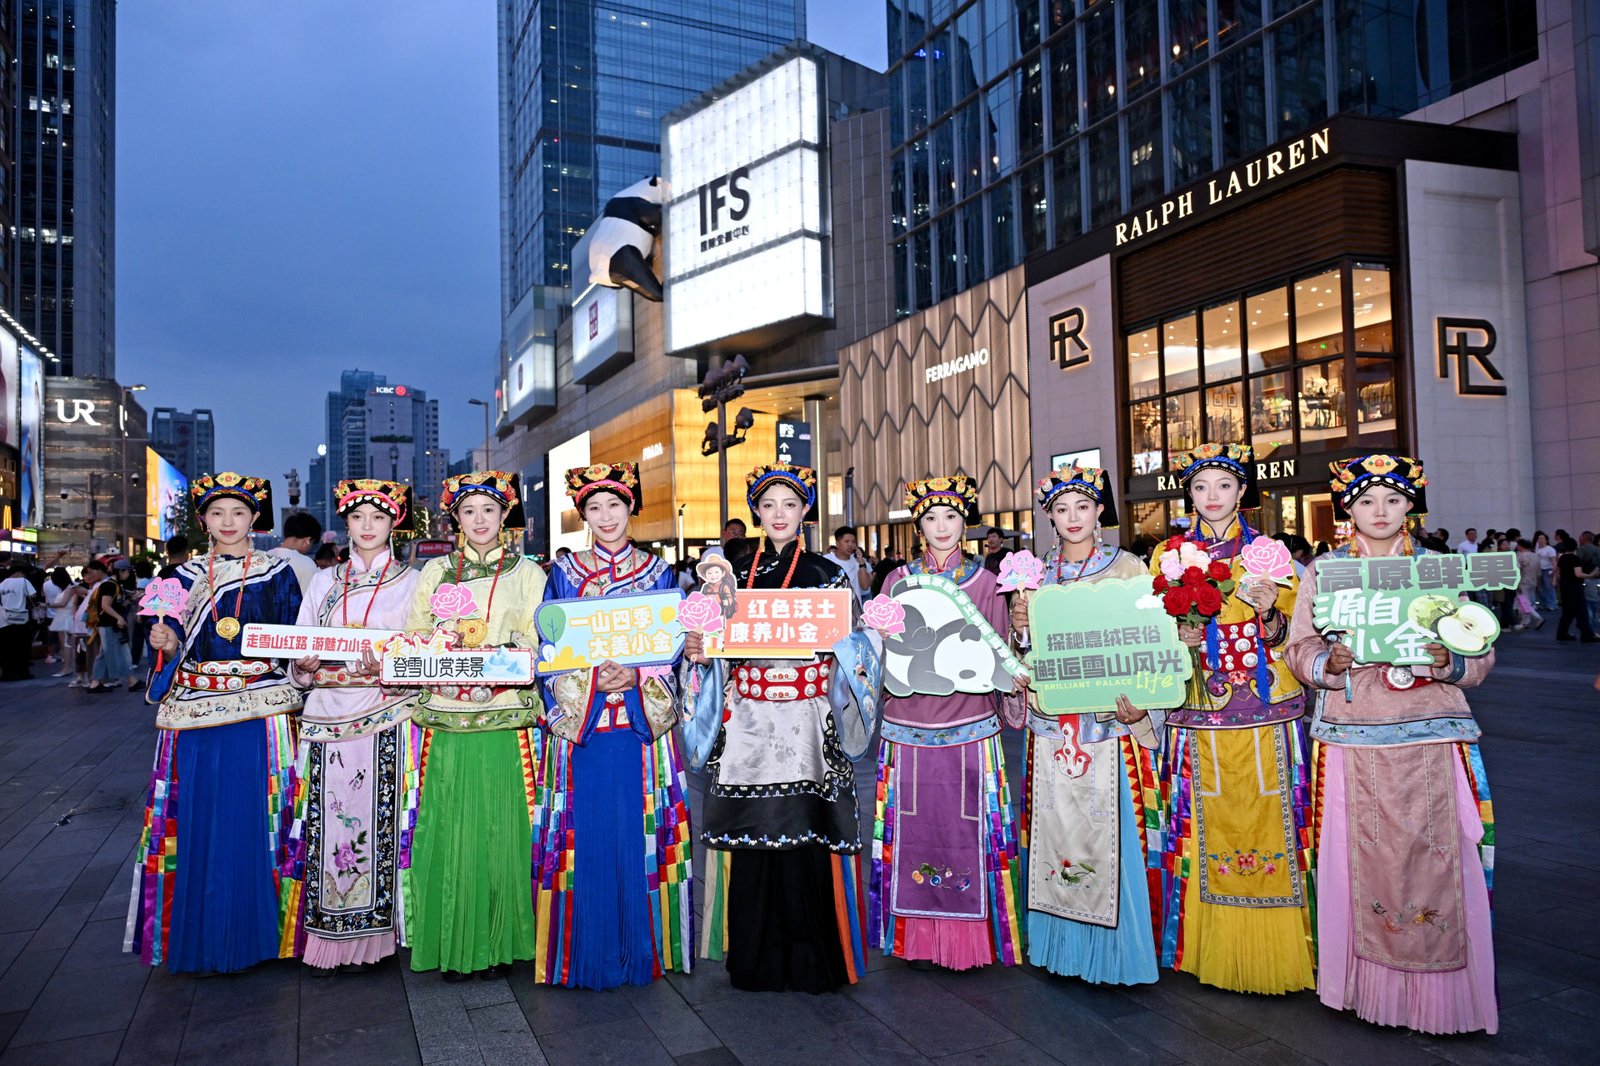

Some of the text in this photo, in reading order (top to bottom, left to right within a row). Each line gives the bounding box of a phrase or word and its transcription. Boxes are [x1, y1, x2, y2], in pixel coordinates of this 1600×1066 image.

[1115, 127, 1330, 246] RALPH LAUREN
[699, 166, 750, 236] IFS
[925, 348, 989, 384] FERRAGAMO
[376, 386, 394, 394] ICBC
[55, 398, 102, 426] UR
[1256, 459, 1295, 480] REN
[1317, 553, 1518, 594] 高原鲜果
[569, 605, 654, 634] 一山四季
[747, 598, 837, 619] 红色沃土
[1315, 587, 1402, 628] 源自
[246, 633, 372, 653] 走雪山红路 游魅力小金
[588, 629, 673, 660] 大美小金
[729, 621, 819, 643] 康养小金
[1046, 625, 1162, 652] 探秘嘉绒民俗
[1342, 618, 1438, 663] 小金
[393, 656, 485, 678] 登雪山赏美景
[1032, 649, 1184, 682] 邂逅雪山风光
[1044, 678, 1134, 691] BRILLIANT PALACE
[1136, 671, 1174, 695] Life
